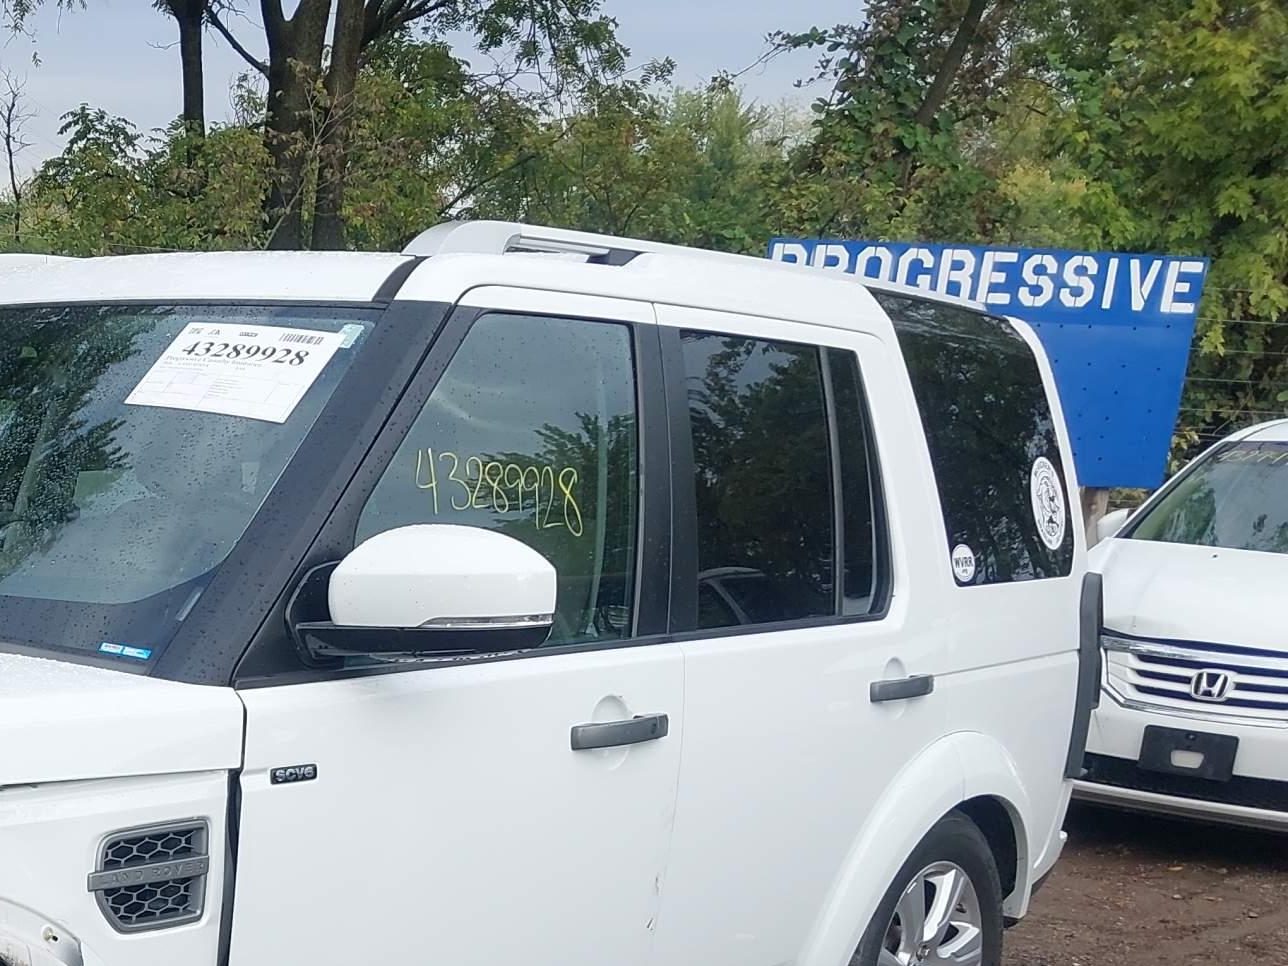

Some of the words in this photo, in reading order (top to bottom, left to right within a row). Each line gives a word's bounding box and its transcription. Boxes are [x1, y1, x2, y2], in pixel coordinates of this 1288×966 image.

[182, 340, 309, 367] 43289928
[415, 448, 583, 537] 43289928
[275, 765, 314, 782] SCV6
